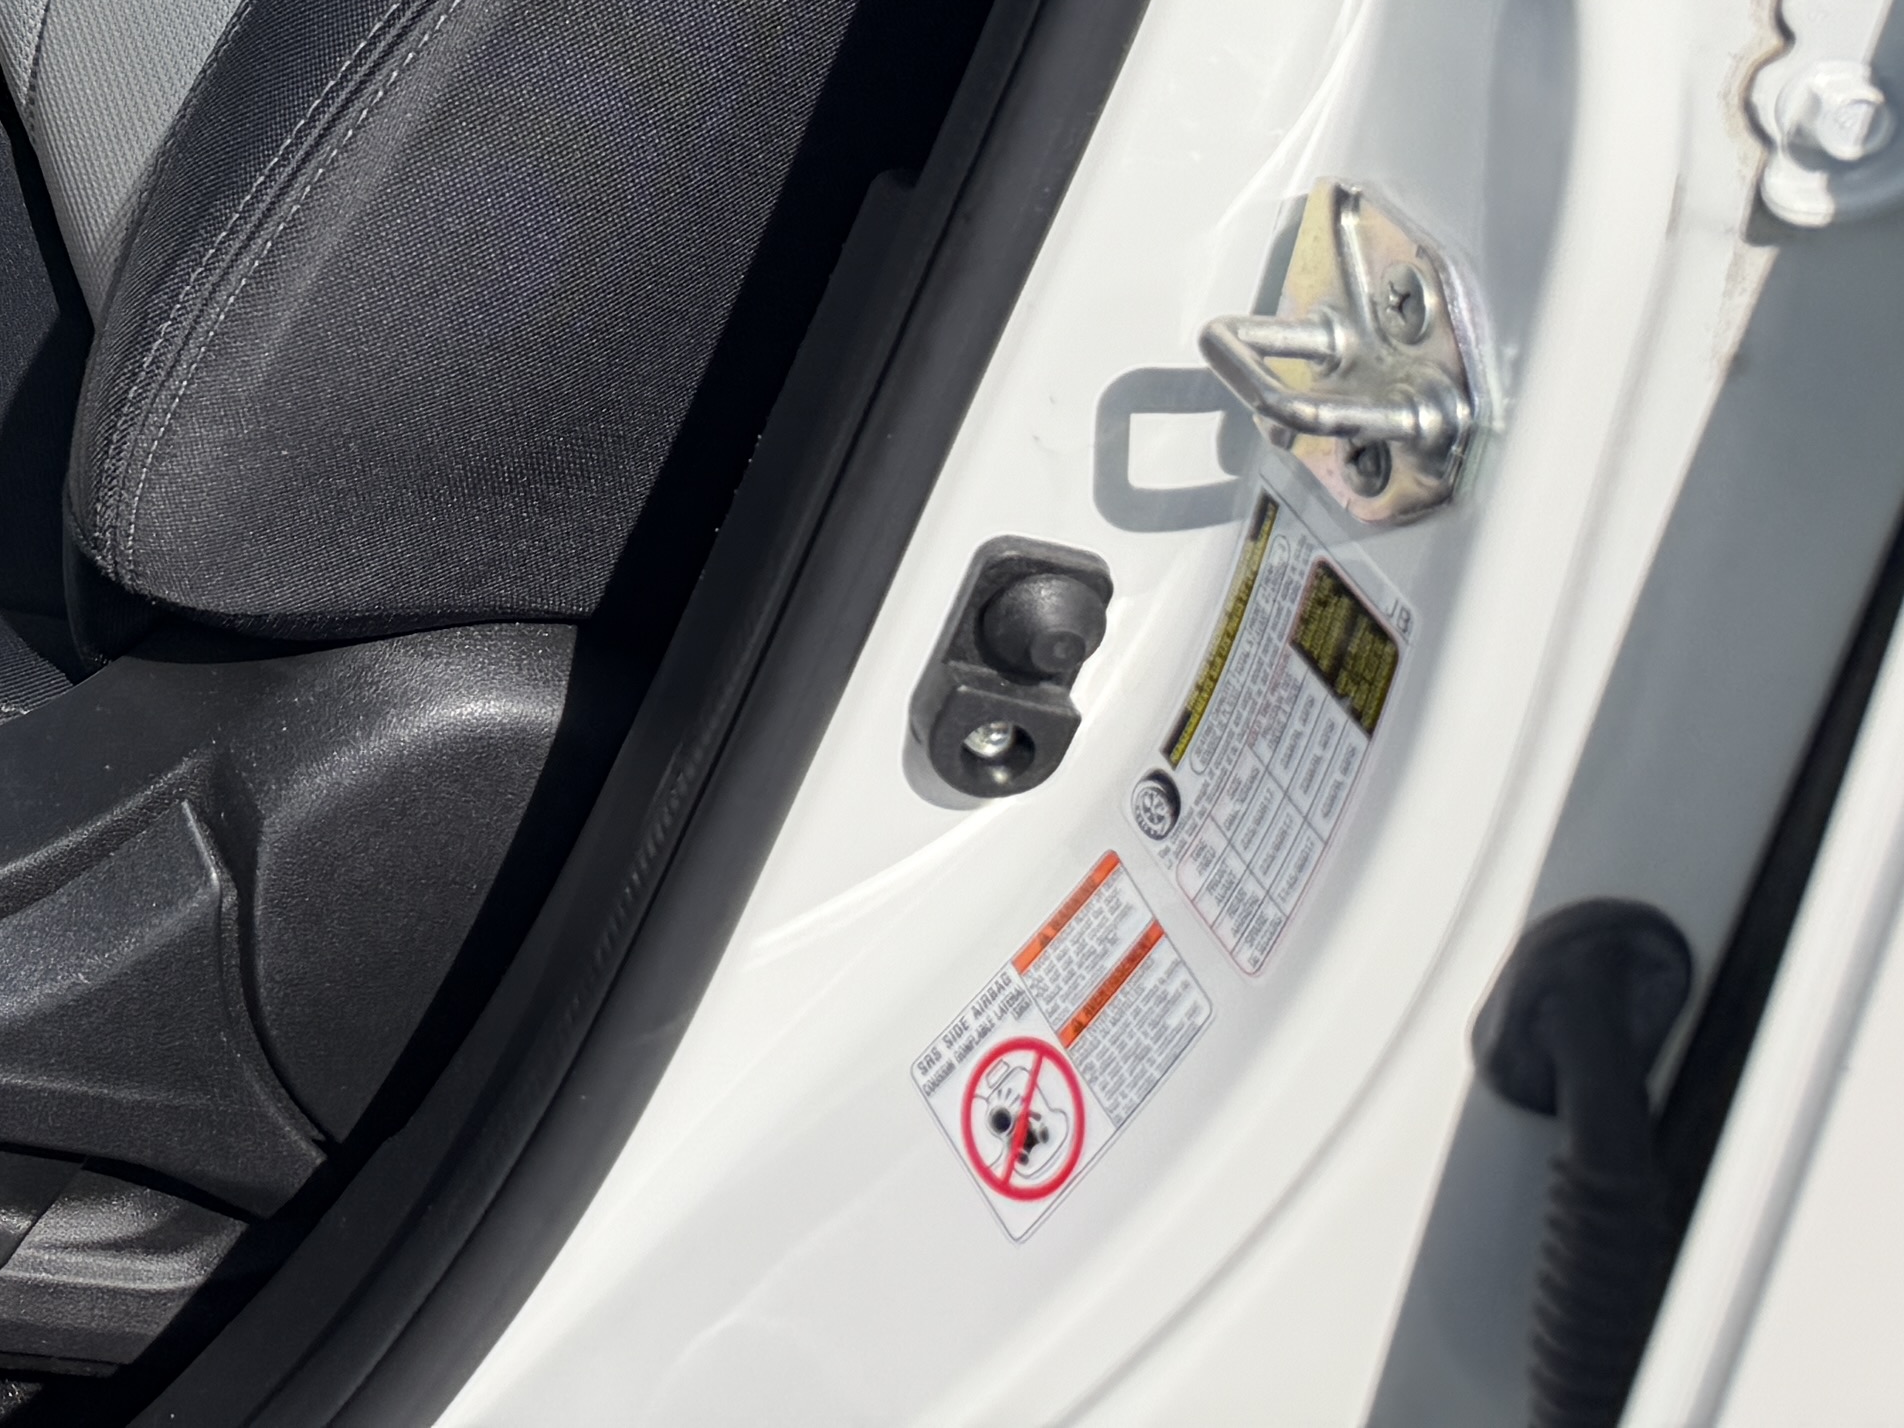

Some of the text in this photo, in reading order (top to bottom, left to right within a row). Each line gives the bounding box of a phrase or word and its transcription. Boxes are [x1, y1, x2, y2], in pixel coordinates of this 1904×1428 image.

[916, 971, 1013, 1077] SRS SIDE AIRBAG
